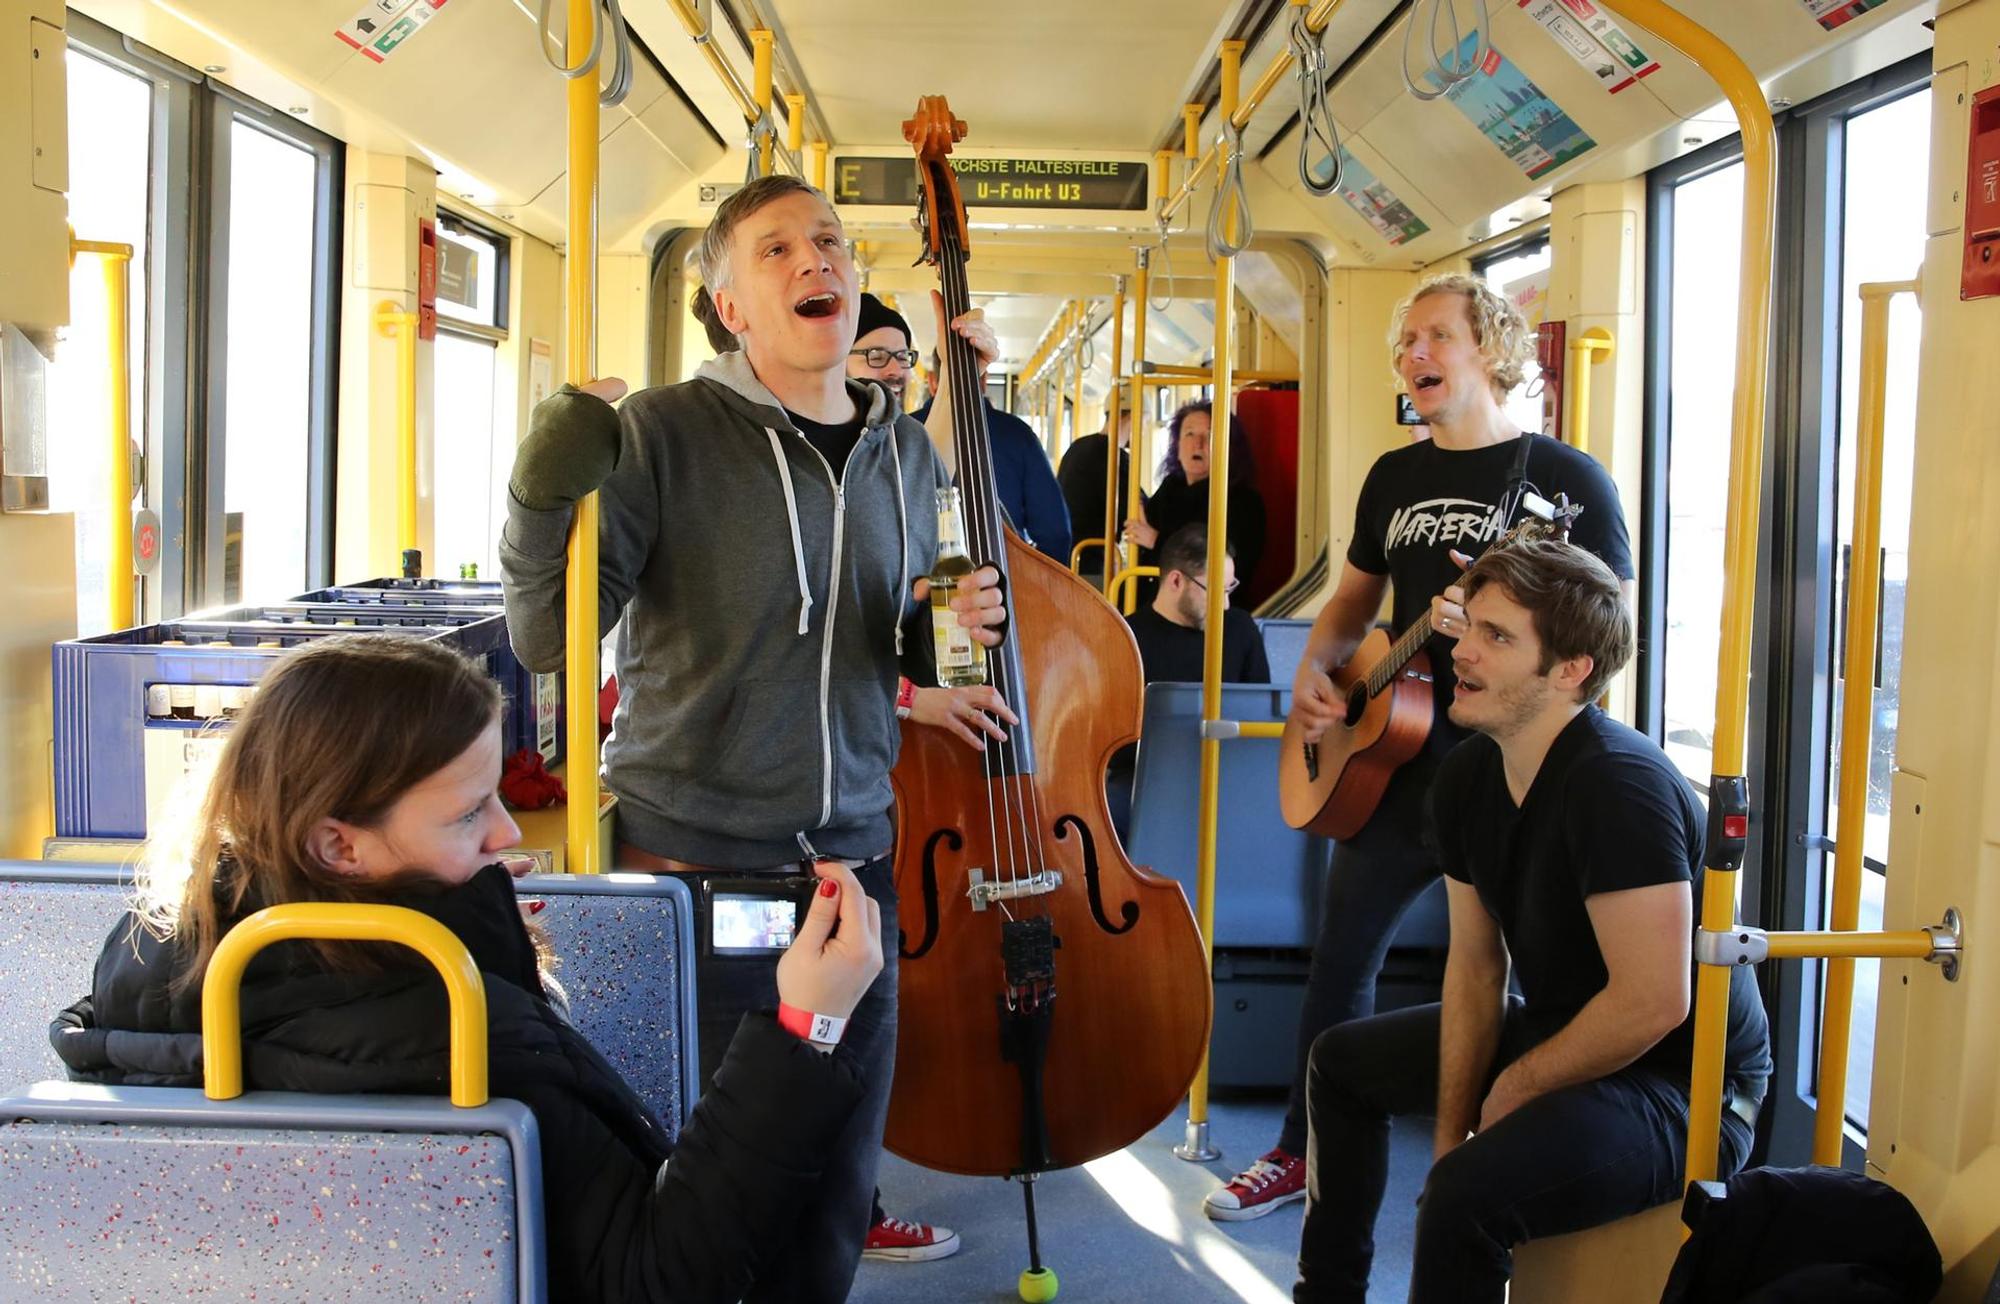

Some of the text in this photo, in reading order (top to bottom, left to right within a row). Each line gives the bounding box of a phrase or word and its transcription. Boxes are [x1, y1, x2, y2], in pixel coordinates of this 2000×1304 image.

[949, 158, 1119, 176] ÄCHSTE HALTESTELLE
[840, 165, 861, 197] E
[977, 182, 1081, 201] U-Fahrt U3
